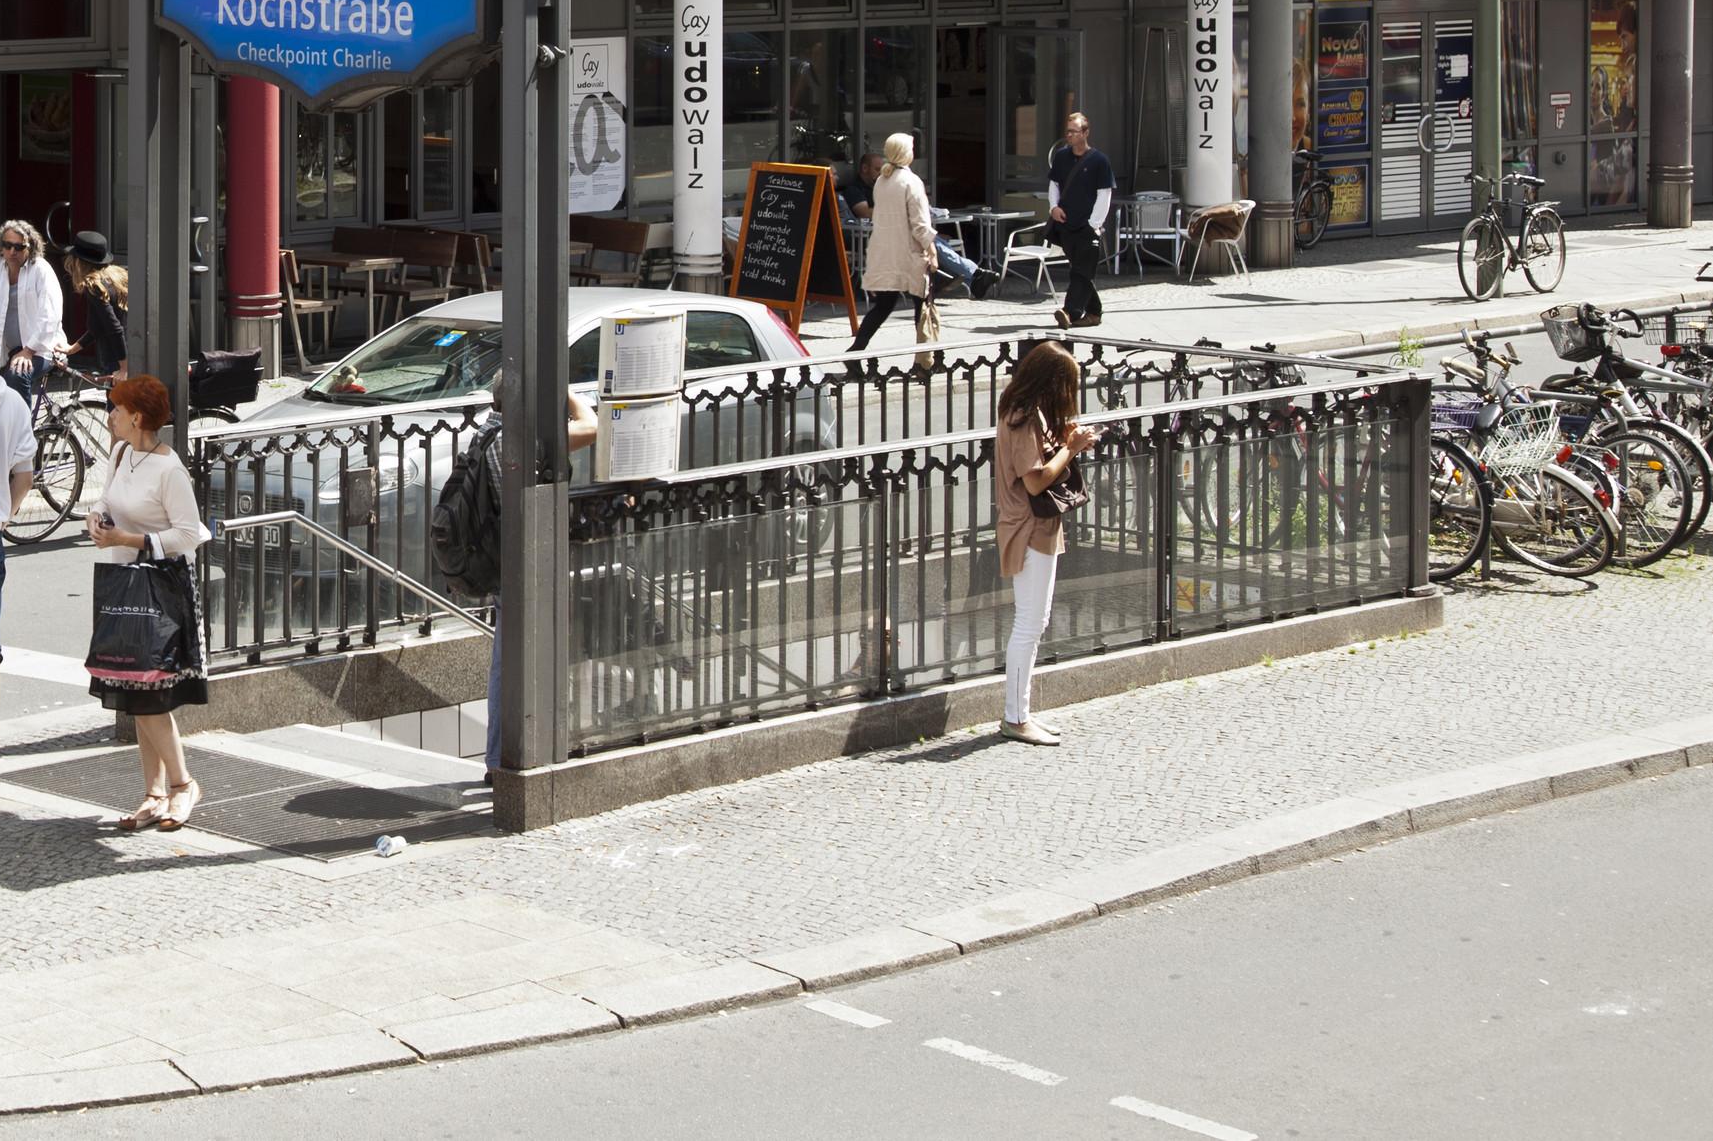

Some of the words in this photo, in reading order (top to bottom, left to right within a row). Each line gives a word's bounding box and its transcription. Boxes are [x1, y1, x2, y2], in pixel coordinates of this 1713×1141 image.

[681, 5, 710, 36] Çay
[237, 42, 328, 69] Checkpoint
[333, 48, 392, 70] Charlie
[581, 52, 600, 78] Çay
[576, 80, 605, 89] udowalz
[615, 323, 624, 335] U
[612, 408, 620, 420] U
